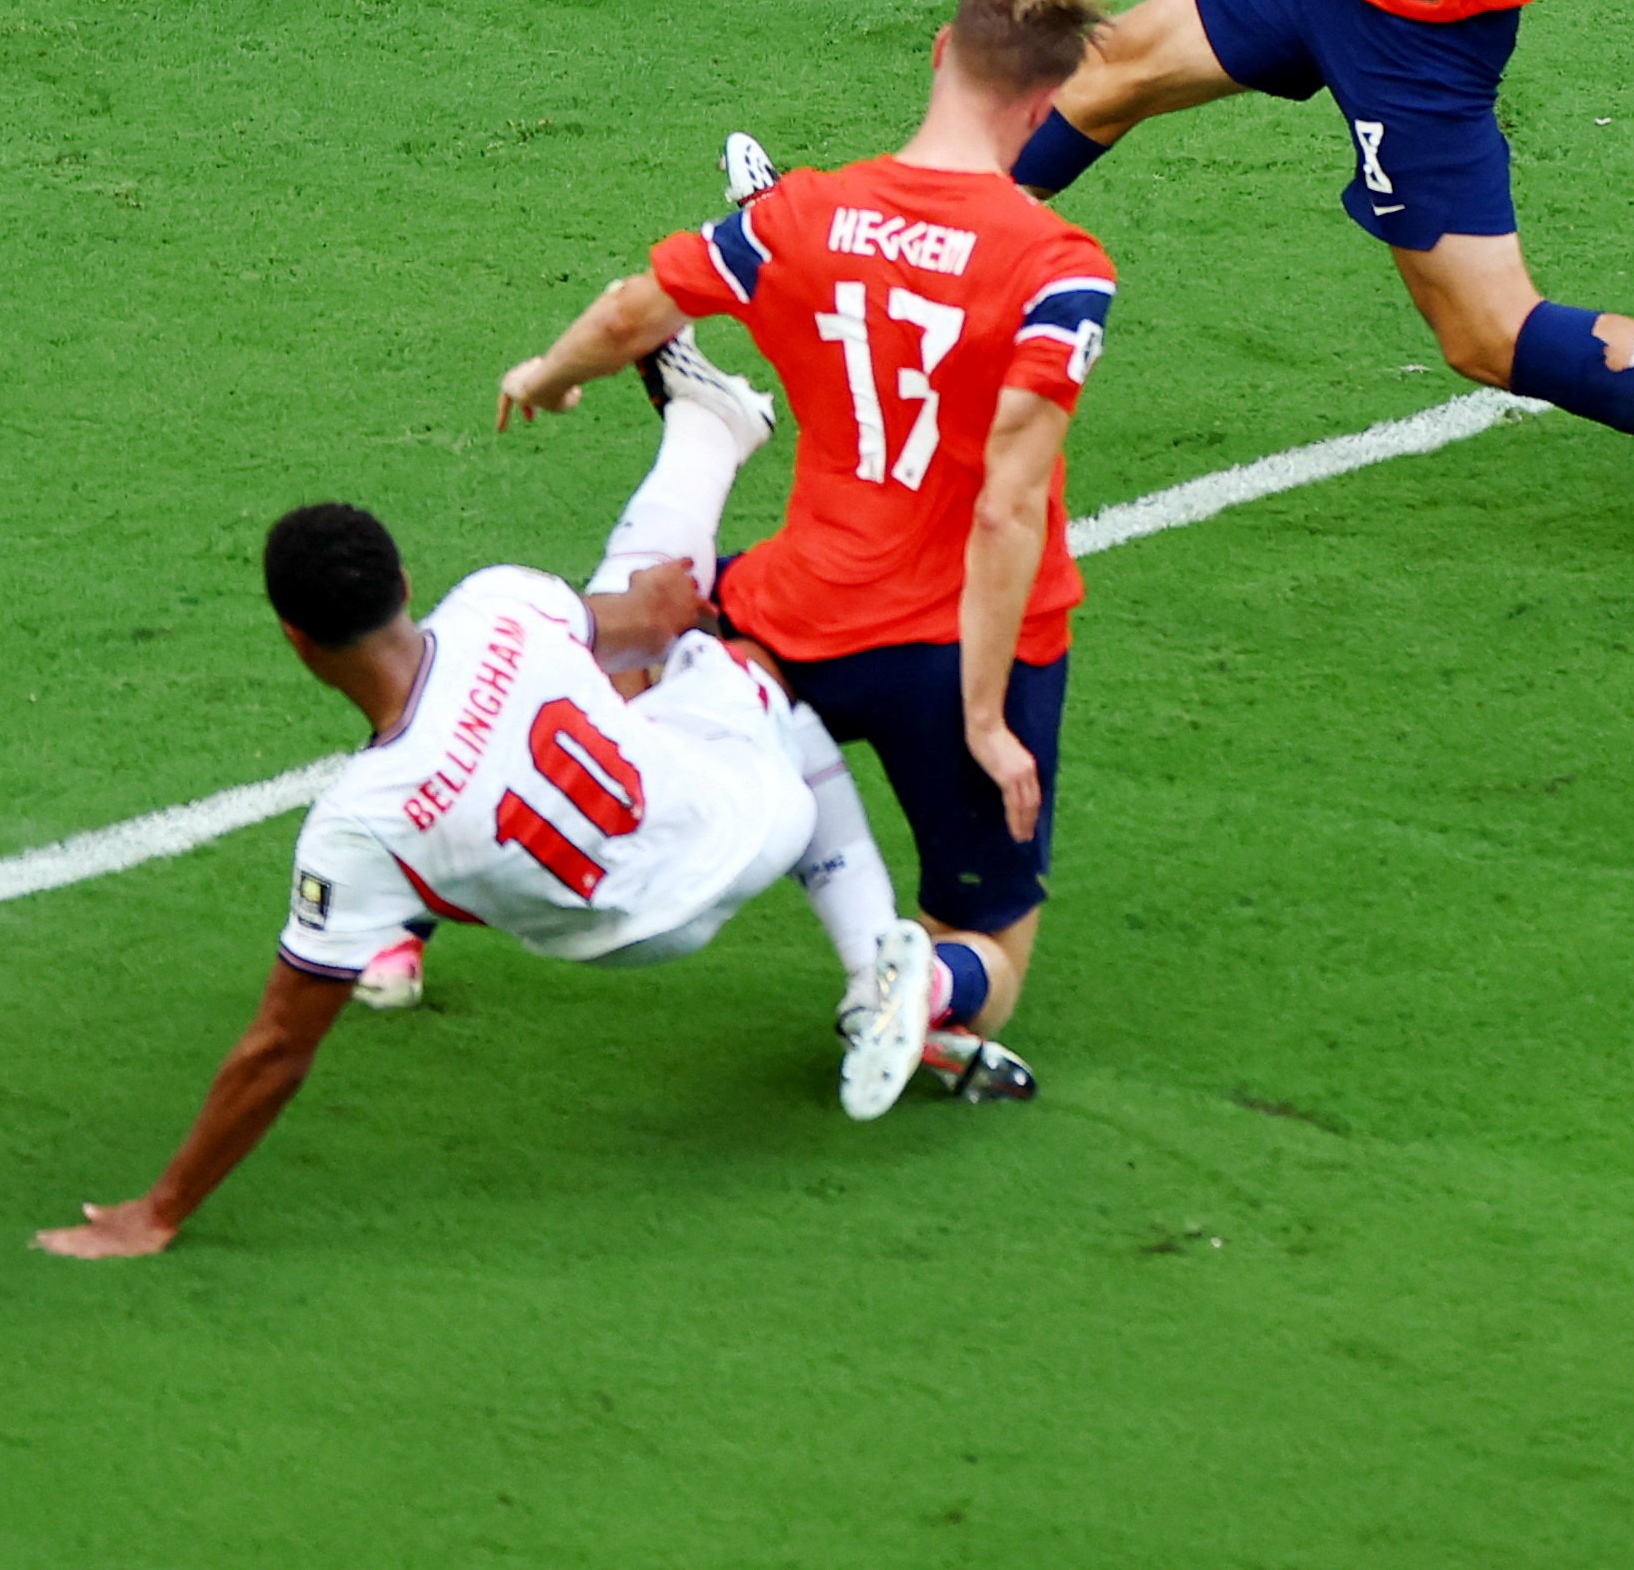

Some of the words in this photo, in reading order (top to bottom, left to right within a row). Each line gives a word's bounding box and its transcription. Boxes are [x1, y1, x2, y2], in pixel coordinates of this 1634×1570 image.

[828, 206, 977, 276] HEGGEM
[403, 615, 526, 832] BELLINGHAM
[494, 697, 645, 901] 10
